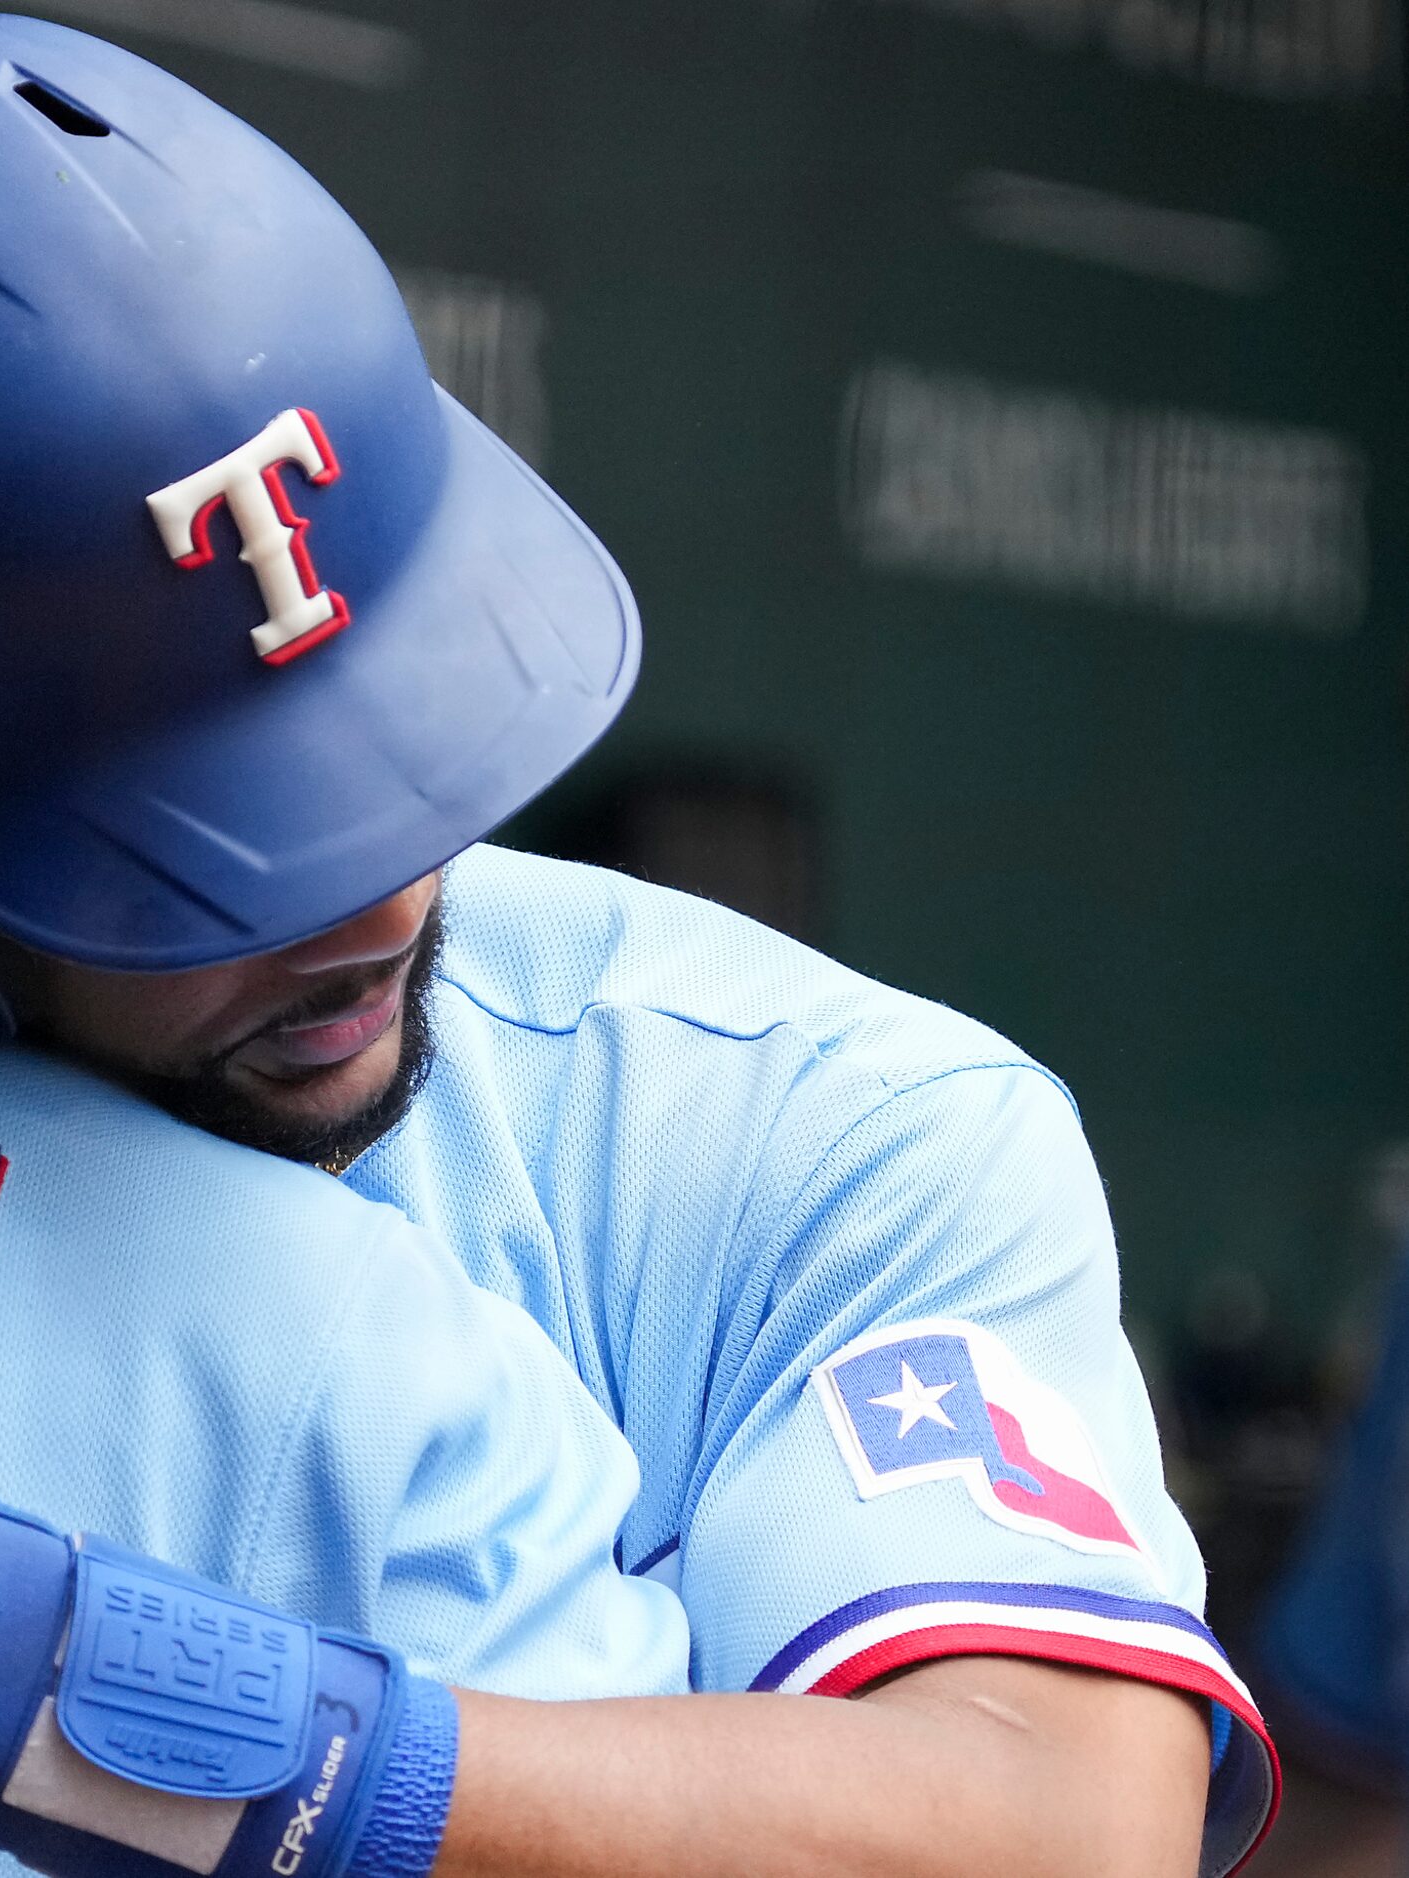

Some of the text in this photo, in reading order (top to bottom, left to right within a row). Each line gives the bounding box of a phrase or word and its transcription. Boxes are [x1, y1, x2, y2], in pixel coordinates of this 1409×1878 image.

[145, 407, 351, 667] T
[104, 1584, 288, 1655] SERIES
[270, 1734, 347, 1877] CFX SLIDER
